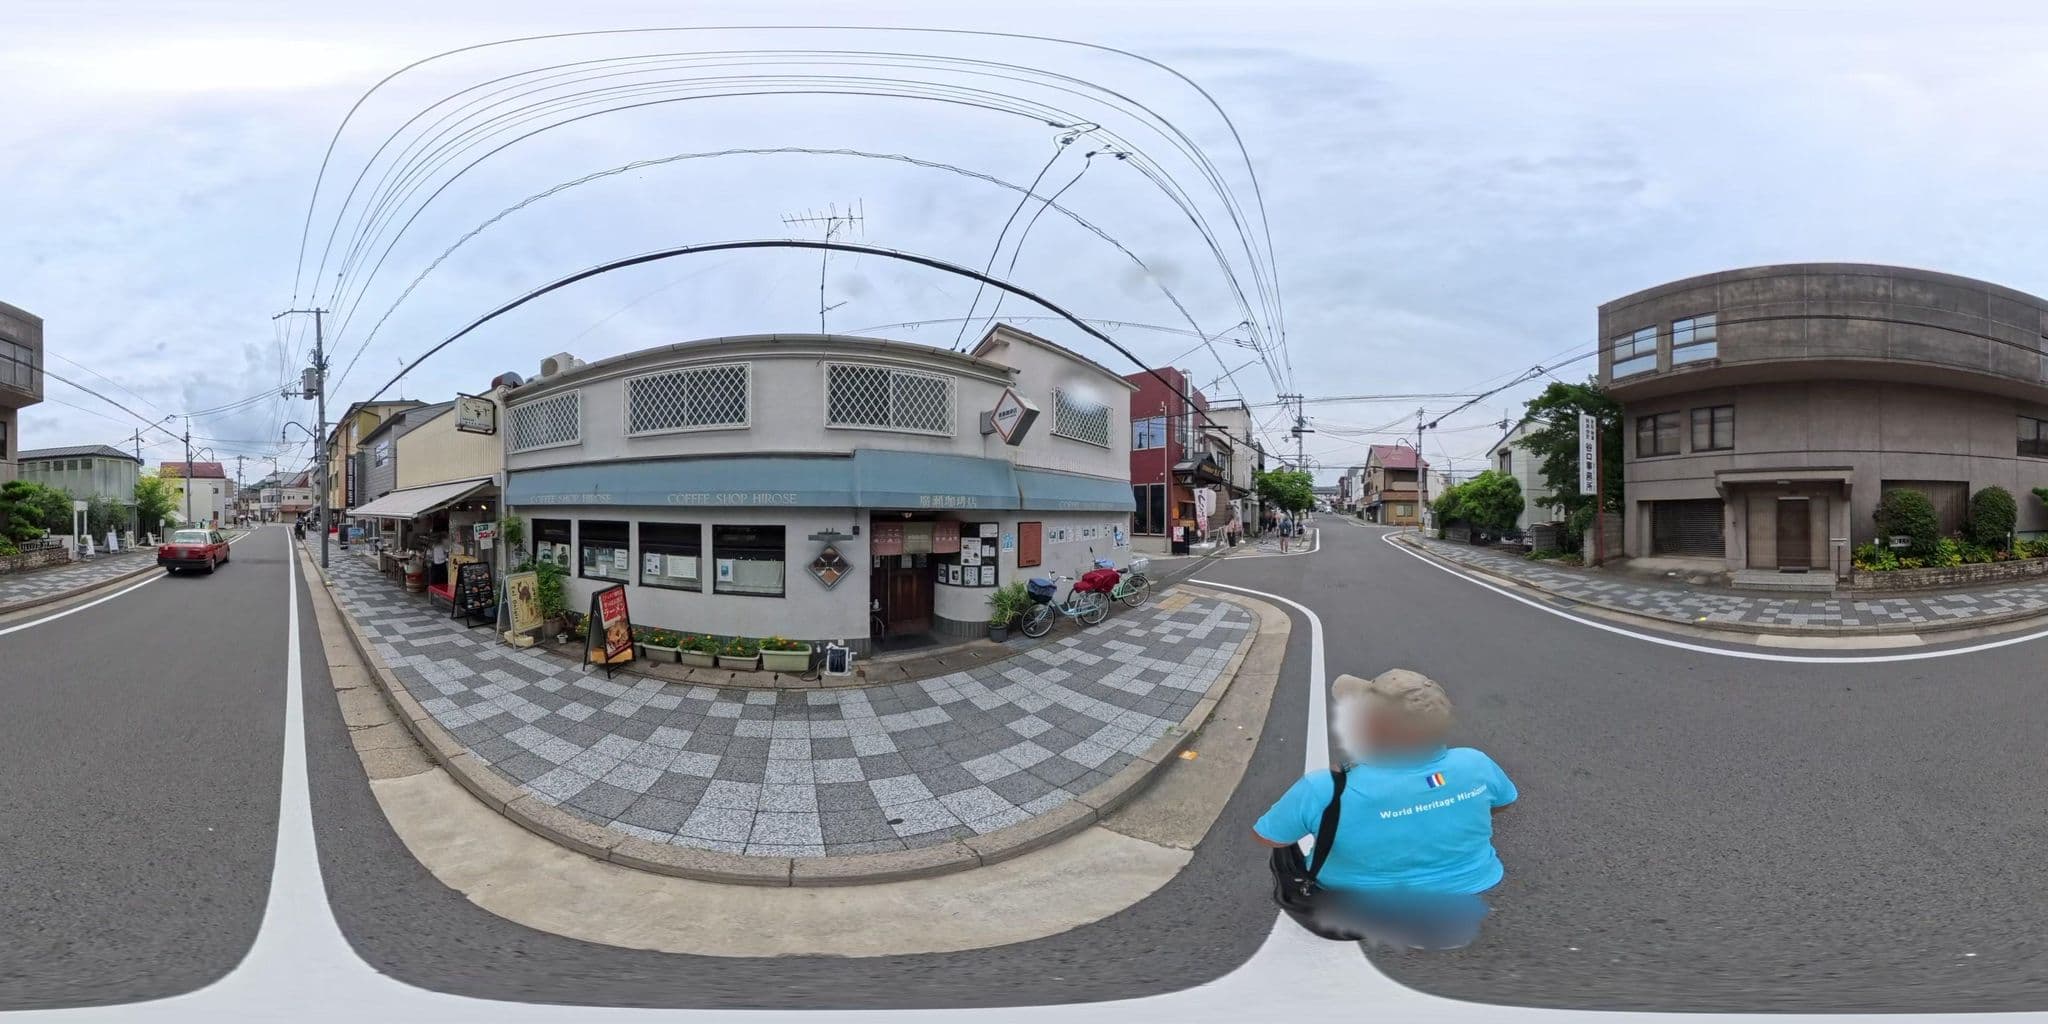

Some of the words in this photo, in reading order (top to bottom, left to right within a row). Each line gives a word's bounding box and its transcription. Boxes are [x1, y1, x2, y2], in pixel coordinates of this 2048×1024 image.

[667, 493, 711, 505] COFFEE
[716, 493, 748, 505] SHOP
[752, 493, 798, 504] HIROSE
[1379, 807, 1413, 820] World
[1415, 796, 1455, 813] Heritage
